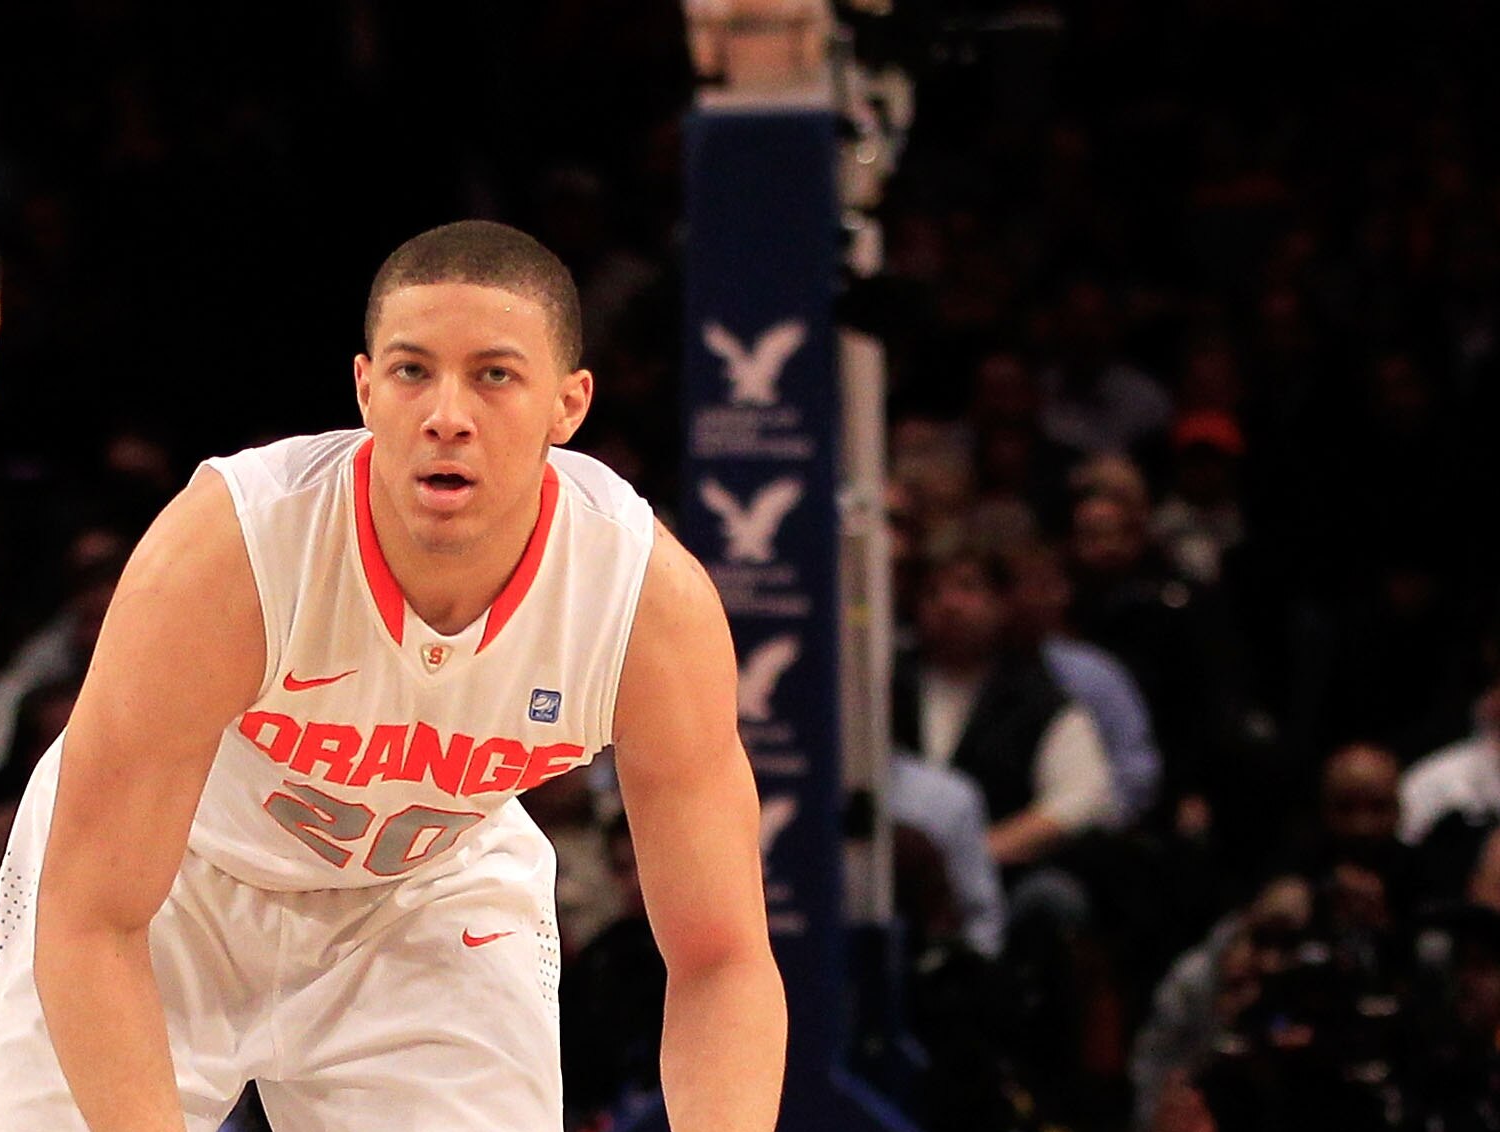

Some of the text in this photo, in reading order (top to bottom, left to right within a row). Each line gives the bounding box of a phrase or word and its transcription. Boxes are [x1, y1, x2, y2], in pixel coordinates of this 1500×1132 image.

[428, 646, 443, 665] S
[238, 710, 585, 797] ORANGE
[263, 780, 486, 877] 20
